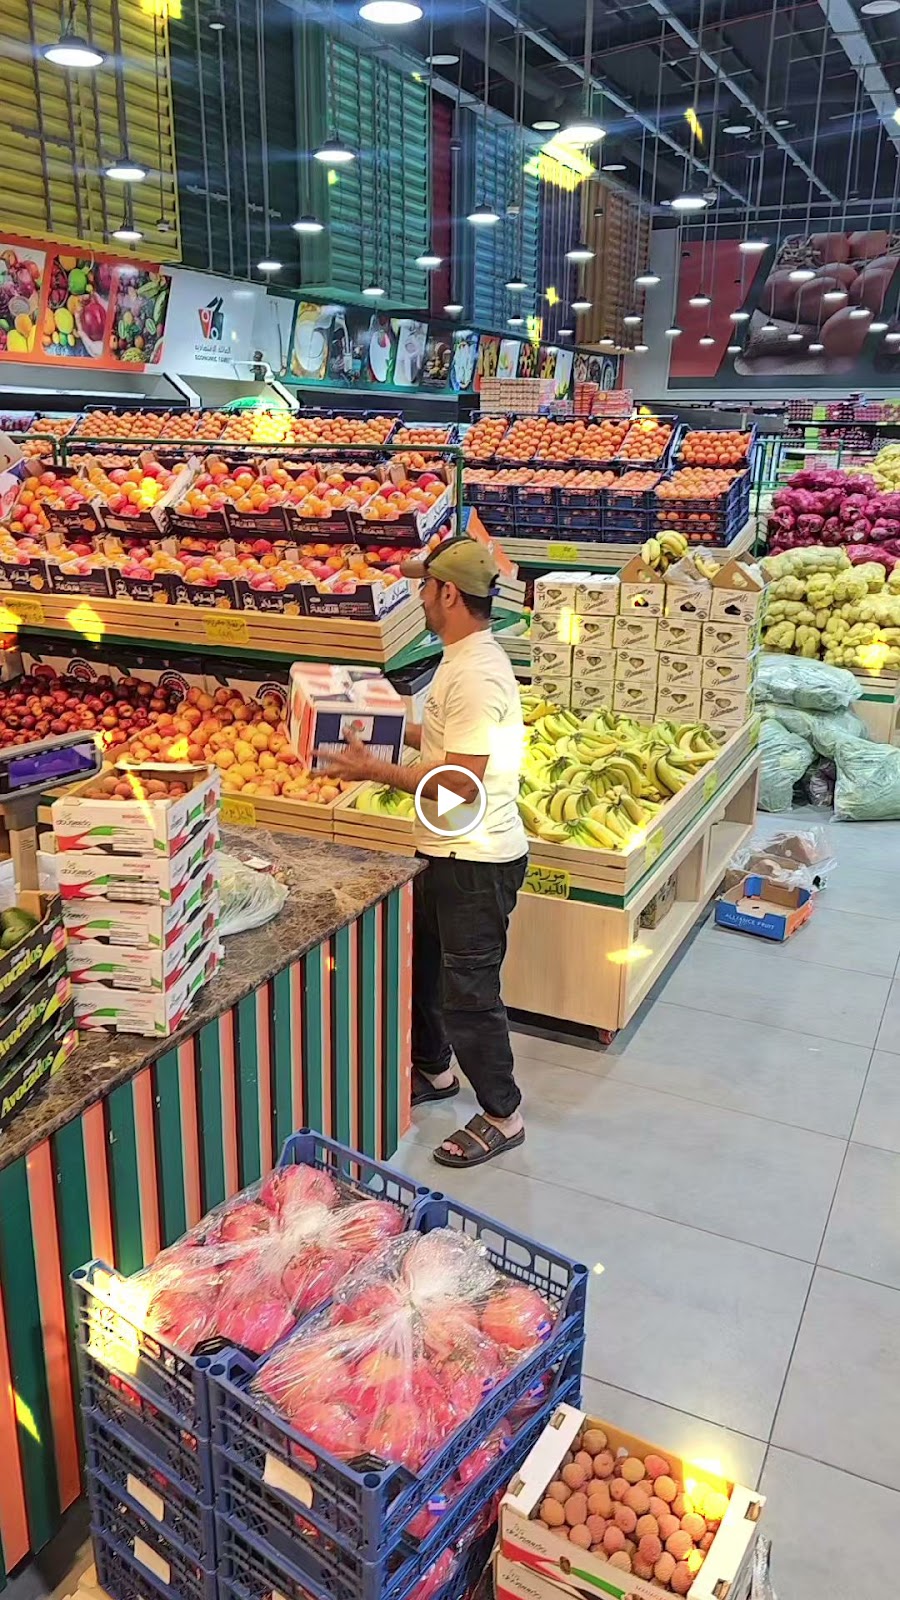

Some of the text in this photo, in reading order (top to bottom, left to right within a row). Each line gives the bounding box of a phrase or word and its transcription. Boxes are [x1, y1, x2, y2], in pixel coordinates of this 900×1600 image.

[724, 913, 775, 930] ALLIANCE FRUIT
[1, 1051, 54, 1119] Avocados
